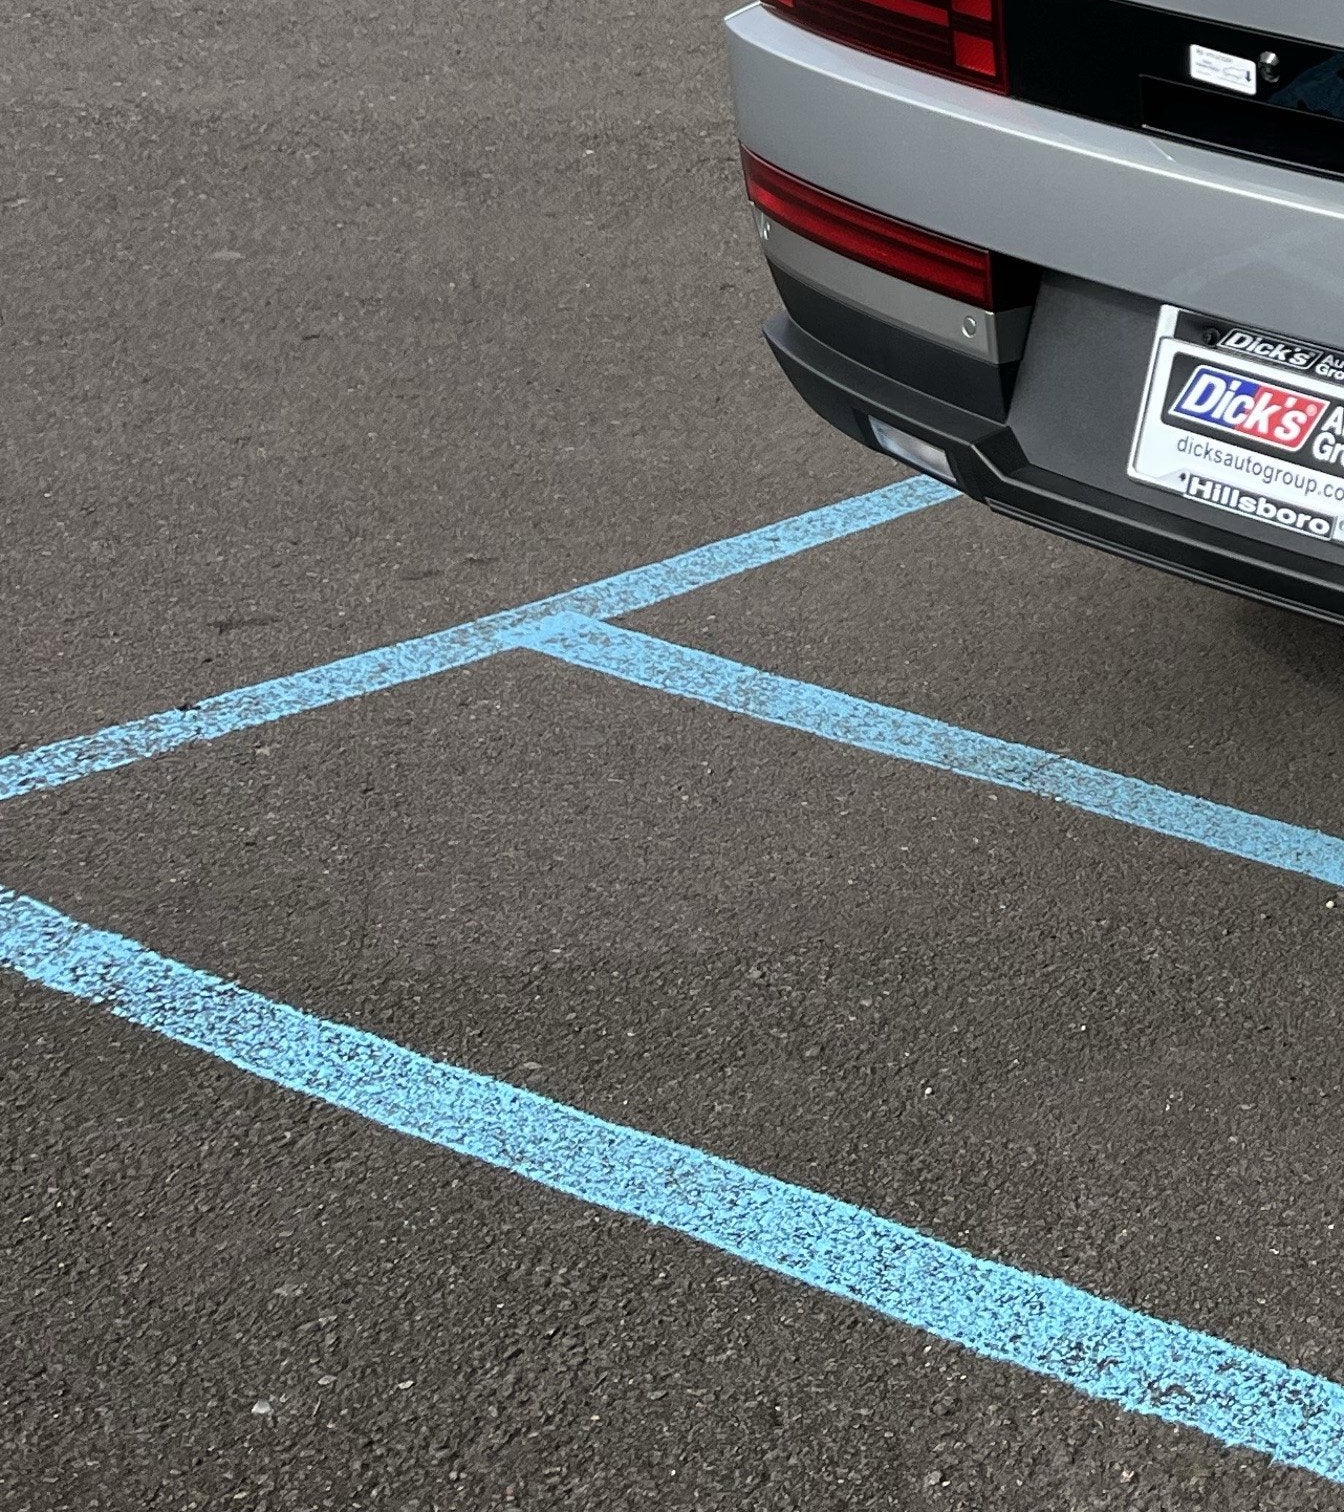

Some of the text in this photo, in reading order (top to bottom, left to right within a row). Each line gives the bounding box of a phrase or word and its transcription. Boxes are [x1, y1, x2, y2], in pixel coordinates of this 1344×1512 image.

[1224, 331, 1312, 367] Dick's
[1181, 373, 1309, 442] Dick's
[1187, 474, 1331, 537] Hillsboro
